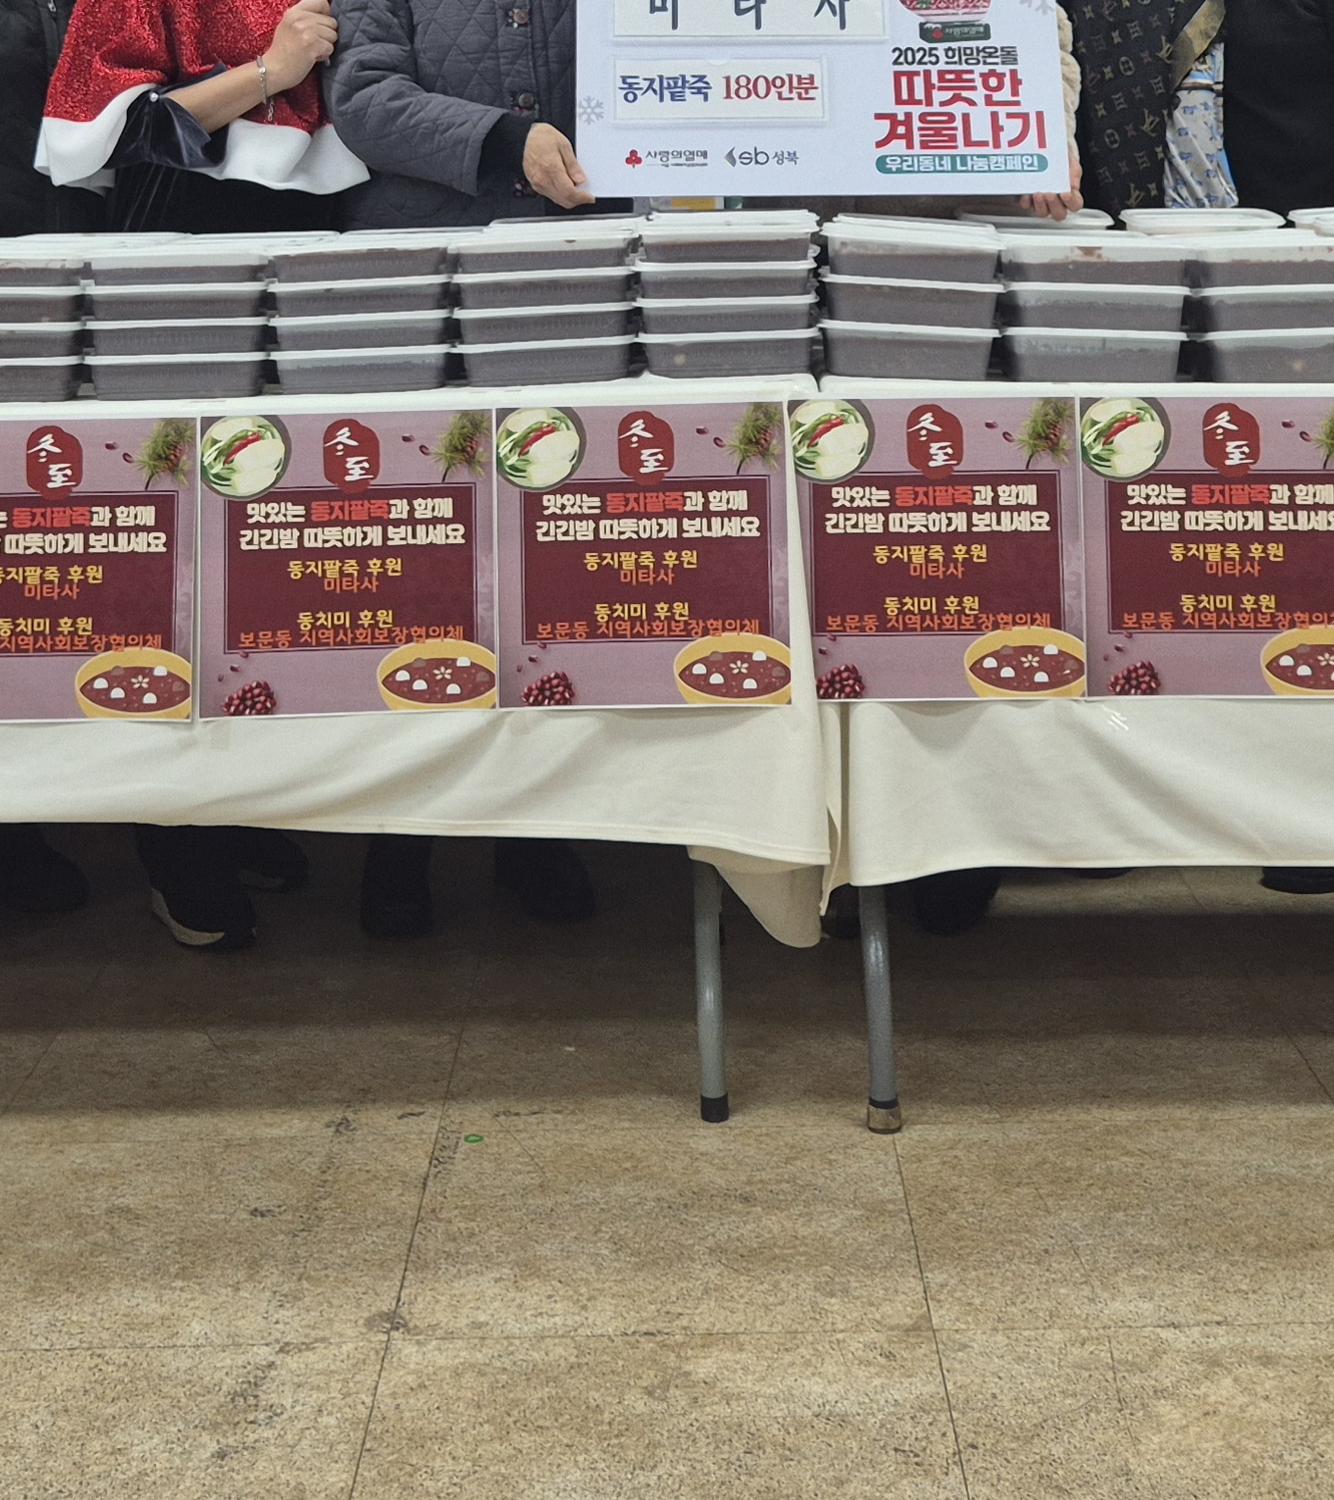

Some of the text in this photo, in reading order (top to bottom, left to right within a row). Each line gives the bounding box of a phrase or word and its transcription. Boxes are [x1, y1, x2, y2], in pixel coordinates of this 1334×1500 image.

[891, 46, 1019, 66] 2025 희망온돌
[618, 73, 819, 103] 동지팥죽 180인분
[893, 69, 1023, 107] 따뜻한
[874, 111, 1047, 150] 겨울나기
[645, 150, 708, 163] 사랑의열매
[739, 146, 799, 166] sb 성북
[885, 155, 1039, 171] 우리동네 나눔캠페인
[543, 490, 749, 514] 맛있는 함께
[832, 487, 890, 507] 맛있는
[998, 484, 1038, 506] 함께
[1127, 484, 1334, 506] 맛있는 함께
[115, 505, 156, 528] 함께
[247, 497, 454, 523] 맛있는 함께
[535, 517, 761, 541] 긴긴밤 따뜻하게 보내세요
[825, 511, 1050, 534] 긴긴밤 따뜻하게 보내세요
[1120, 511, 1181, 532] 긴긴밤
[1184, 511, 1264, 532] 따뜻하게
[4, 534, 84, 555] 따뜻하게
[87, 533, 167, 554] 보내세요
[239, 524, 466, 550] 긴긴밤 따뜻하게 보내세요
[662, 550, 698, 569] 후원
[952, 544, 988, 563] 후원
[1248, 543, 1285, 562] 후원
[67, 566, 103, 585] 후원
[366, 558, 403, 577] 후원
[910, 563, 965, 579] 미타사
[594, 602, 690, 622] 동치미 후원
[884, 596, 980, 616] 동치미 후원
[1180, 594, 1277, 613] 동치미 후원
[57, 617, 93, 635] 후원
[297, 610, 394, 630] 동치미 후원
[825, 614, 880, 632] 보문동
